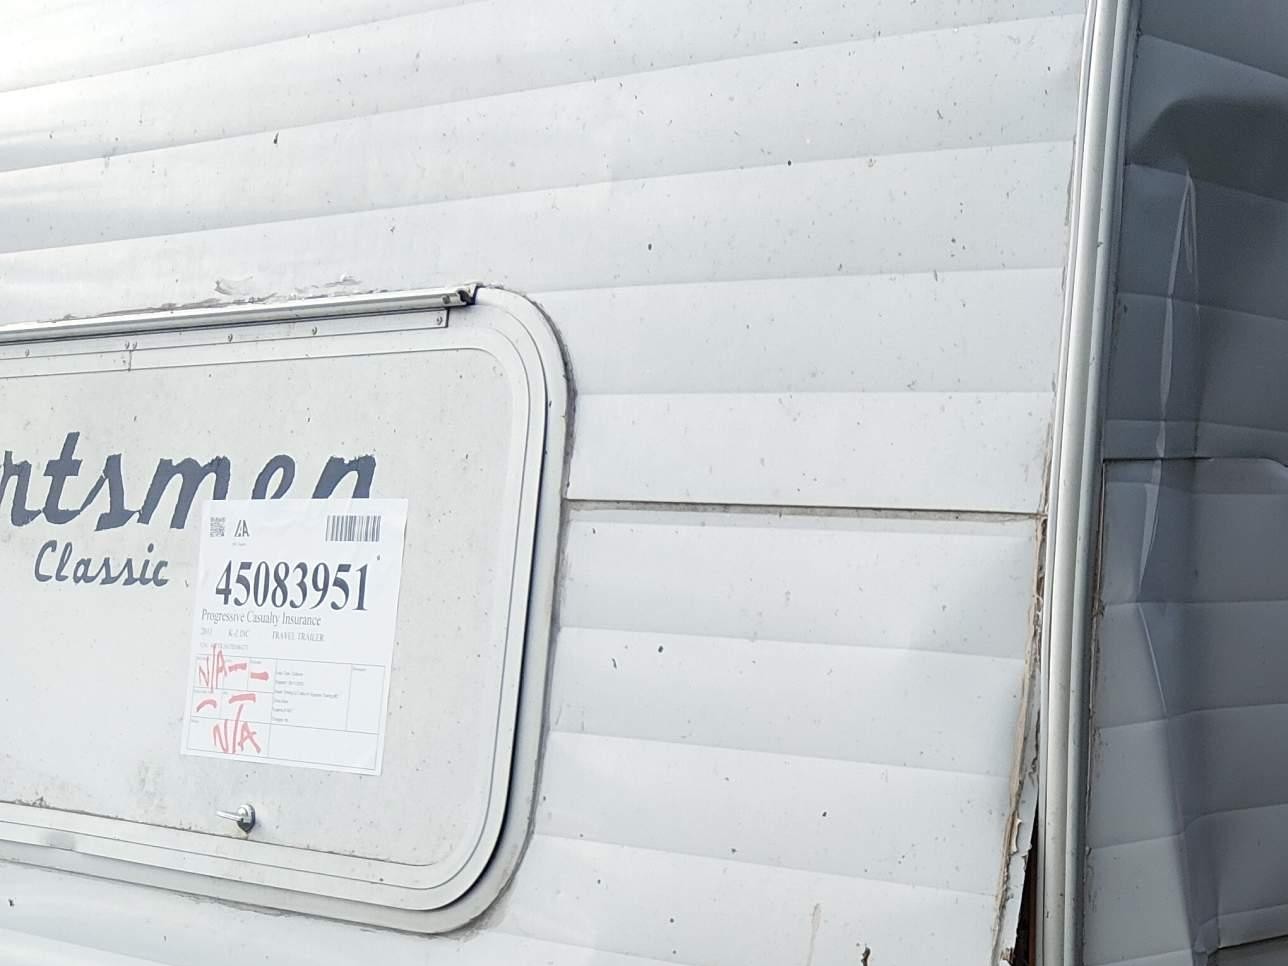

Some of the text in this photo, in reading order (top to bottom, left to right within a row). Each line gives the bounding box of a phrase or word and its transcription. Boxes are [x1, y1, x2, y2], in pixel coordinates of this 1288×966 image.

[34, 540, 169, 587] Classic
[215, 559, 369, 611] 45083951
[201, 608, 322, 627] Progressive Casualty Insurance
[213, 704, 262, 754] N/A
